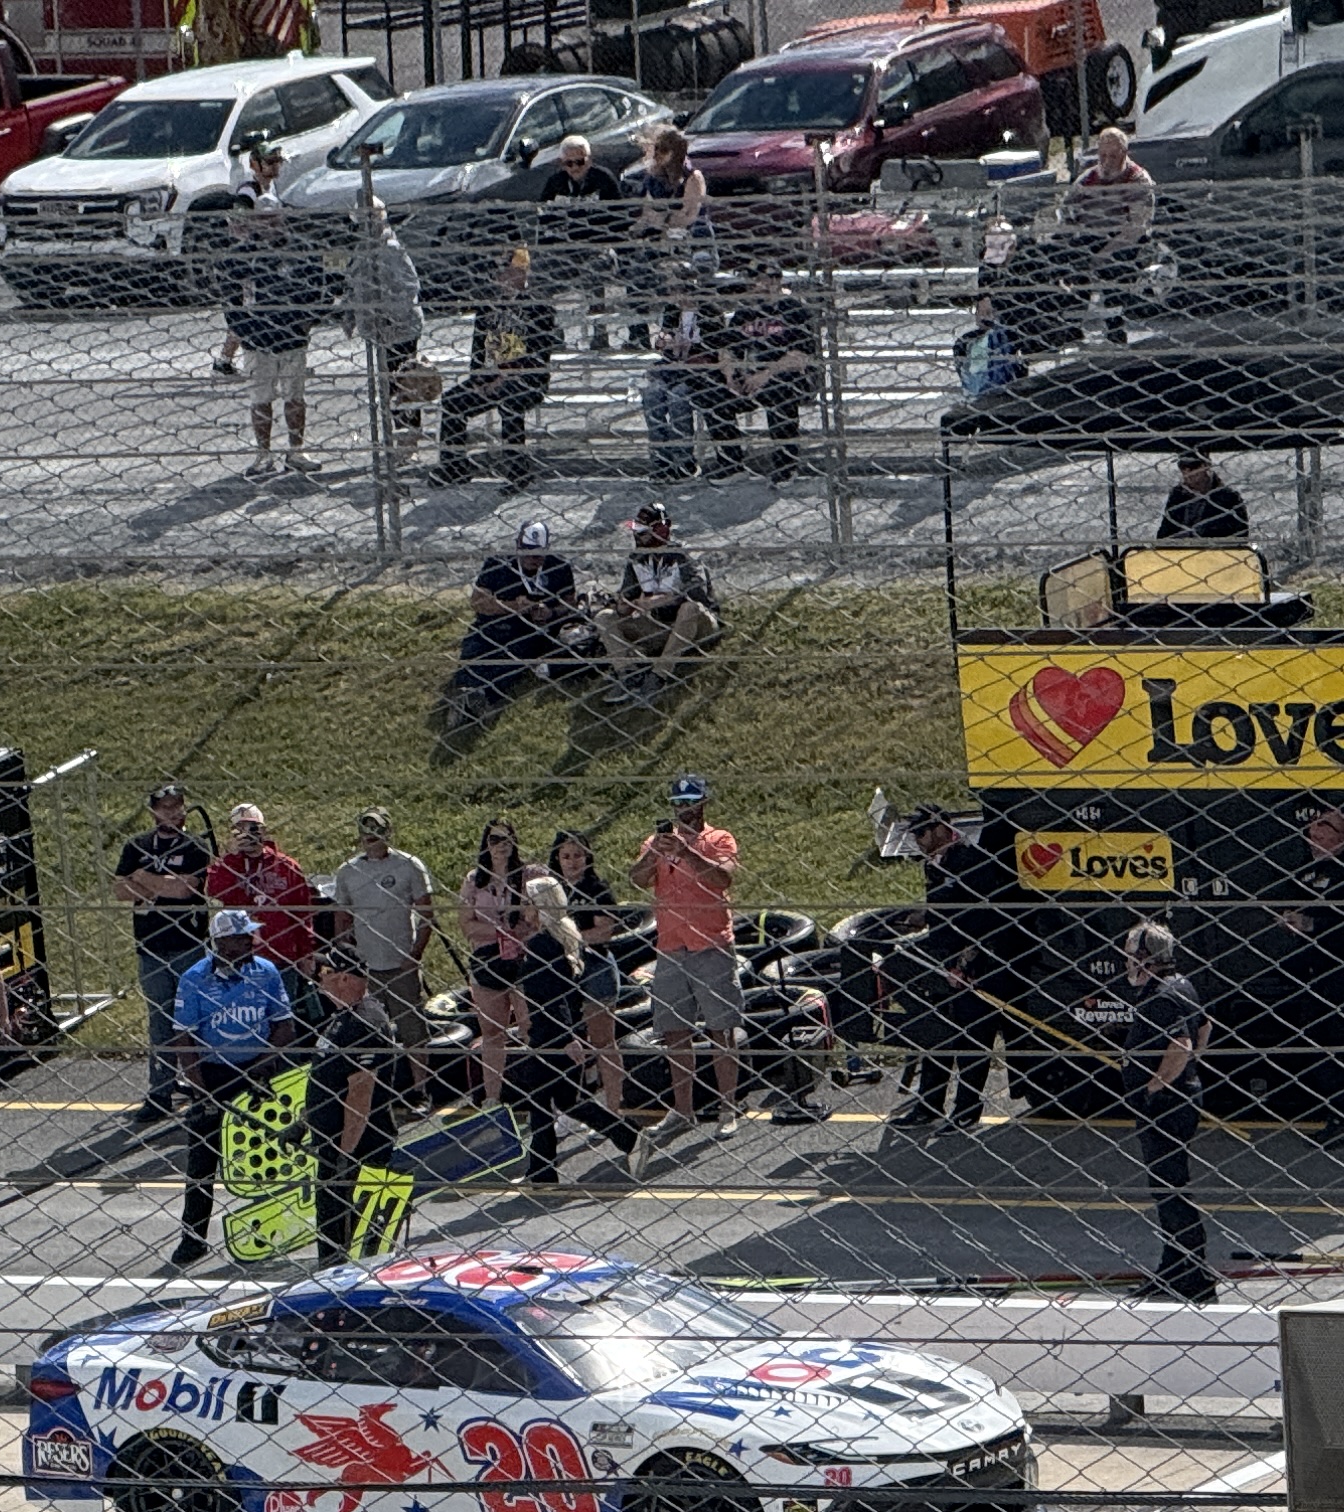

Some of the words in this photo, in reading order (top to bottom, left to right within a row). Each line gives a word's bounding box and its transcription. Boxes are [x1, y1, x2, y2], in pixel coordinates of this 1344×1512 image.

[93, 1367, 232, 1421] Mobil
[685, 1451, 729, 1476] EAGLE
[953, 1442, 1021, 1476] CAMRY
